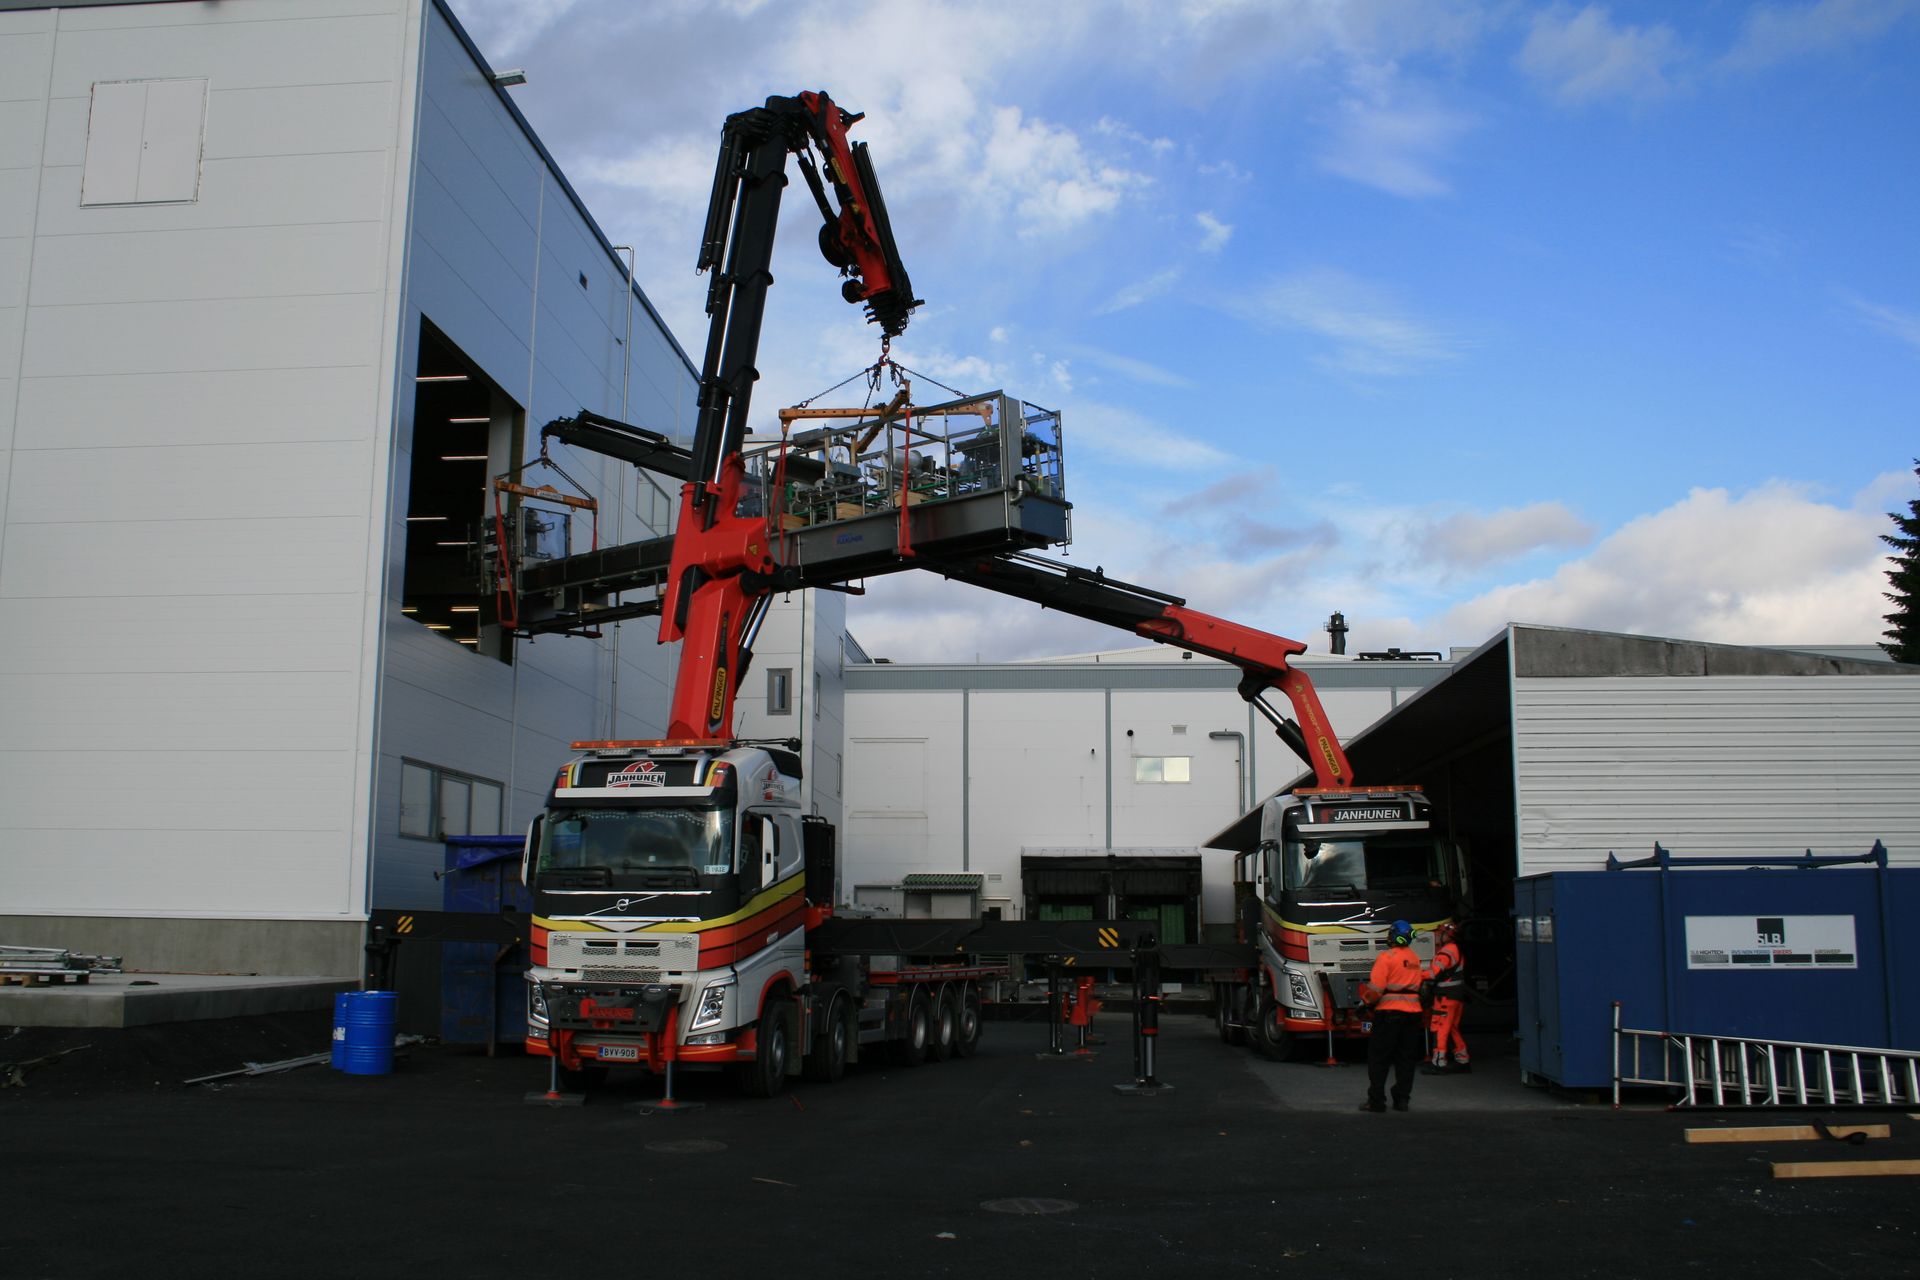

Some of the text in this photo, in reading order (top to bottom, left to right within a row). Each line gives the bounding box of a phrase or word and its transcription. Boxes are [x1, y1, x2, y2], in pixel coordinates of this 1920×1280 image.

[1319, 738, 1340, 774] PALFINGER
[608, 774, 664, 784] JANHUNEN
[1334, 809, 1401, 821] JANHUNEN
[1757, 932, 1782, 945] SLB
[604, 1047, 636, 1058] BVV-908
